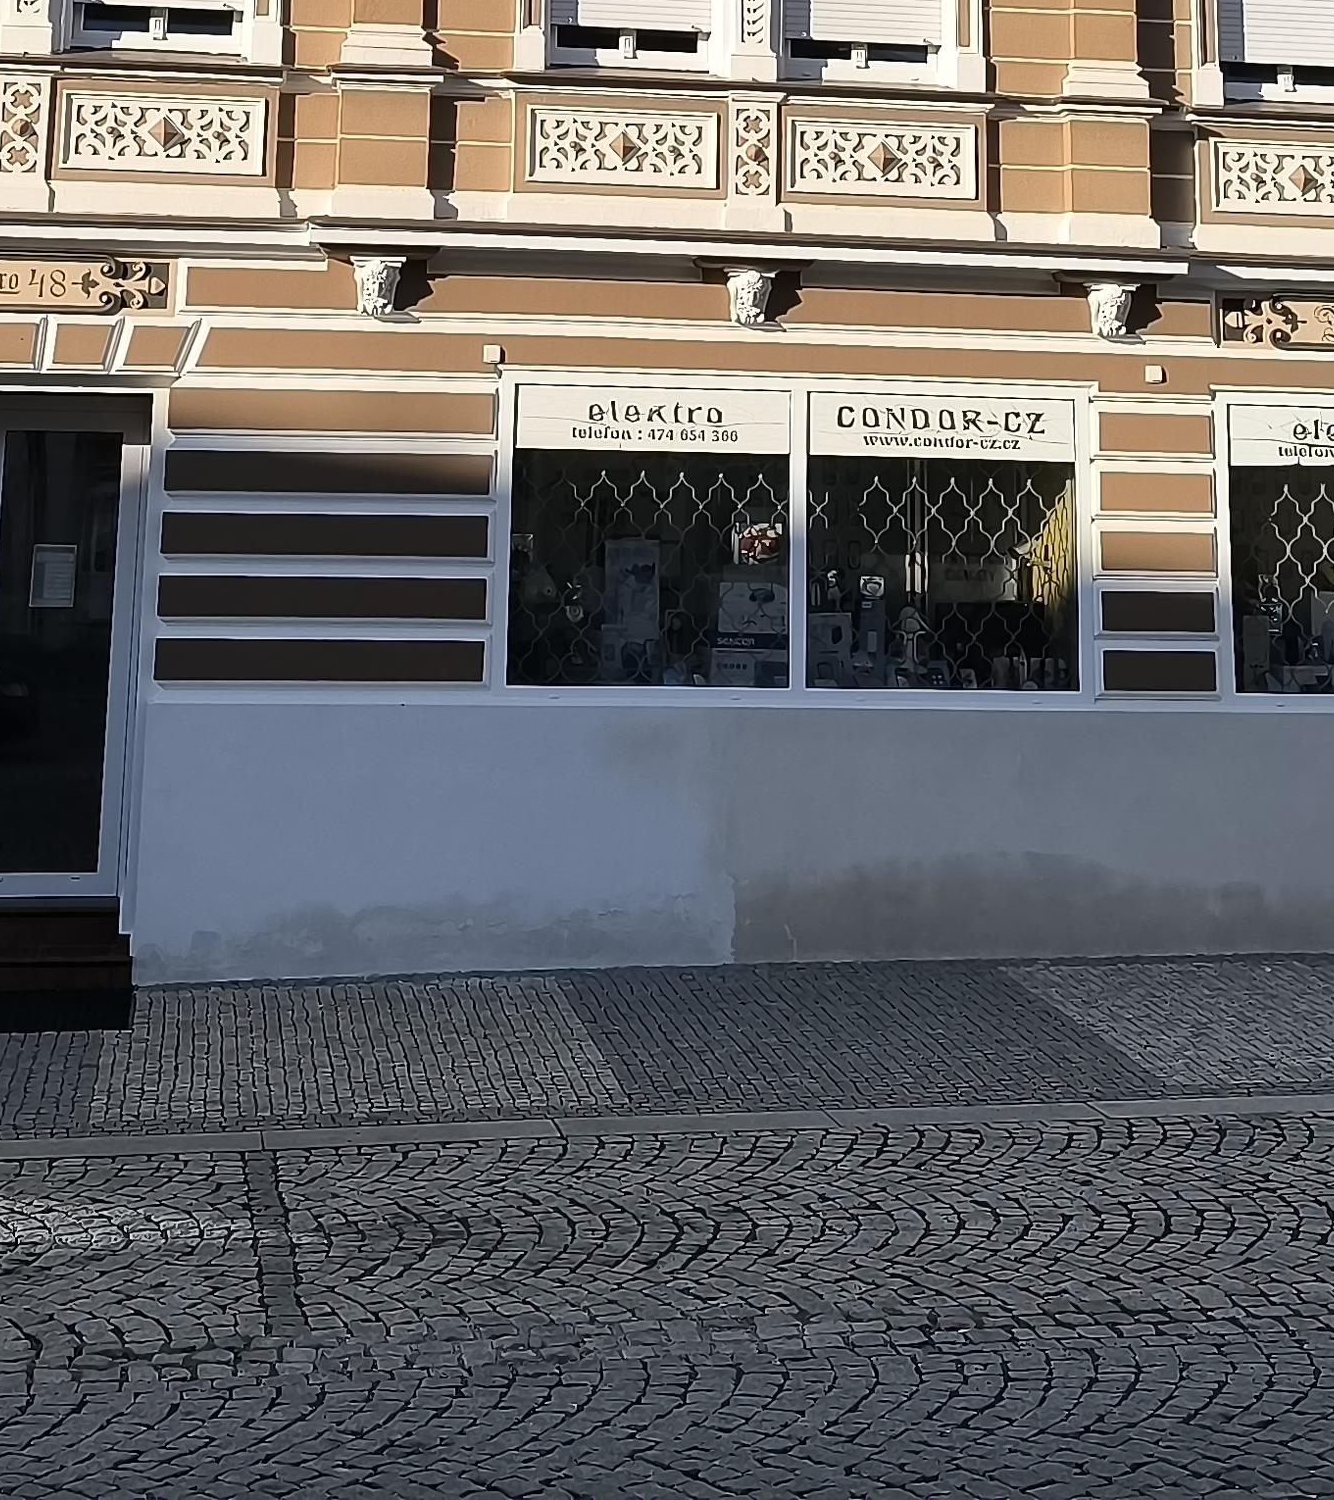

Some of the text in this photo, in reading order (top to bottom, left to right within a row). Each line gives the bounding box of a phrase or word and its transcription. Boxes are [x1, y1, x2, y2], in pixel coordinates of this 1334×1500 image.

[28, 268, 66, 297] 48
[588, 400, 723, 424] elektro
[837, 406, 1045, 434] CONDOR-CZ
[572, 425, 632, 440] telefon
[647, 428, 673, 441] 474
[863, 435, 1021, 450] www.condor-cz.cz
